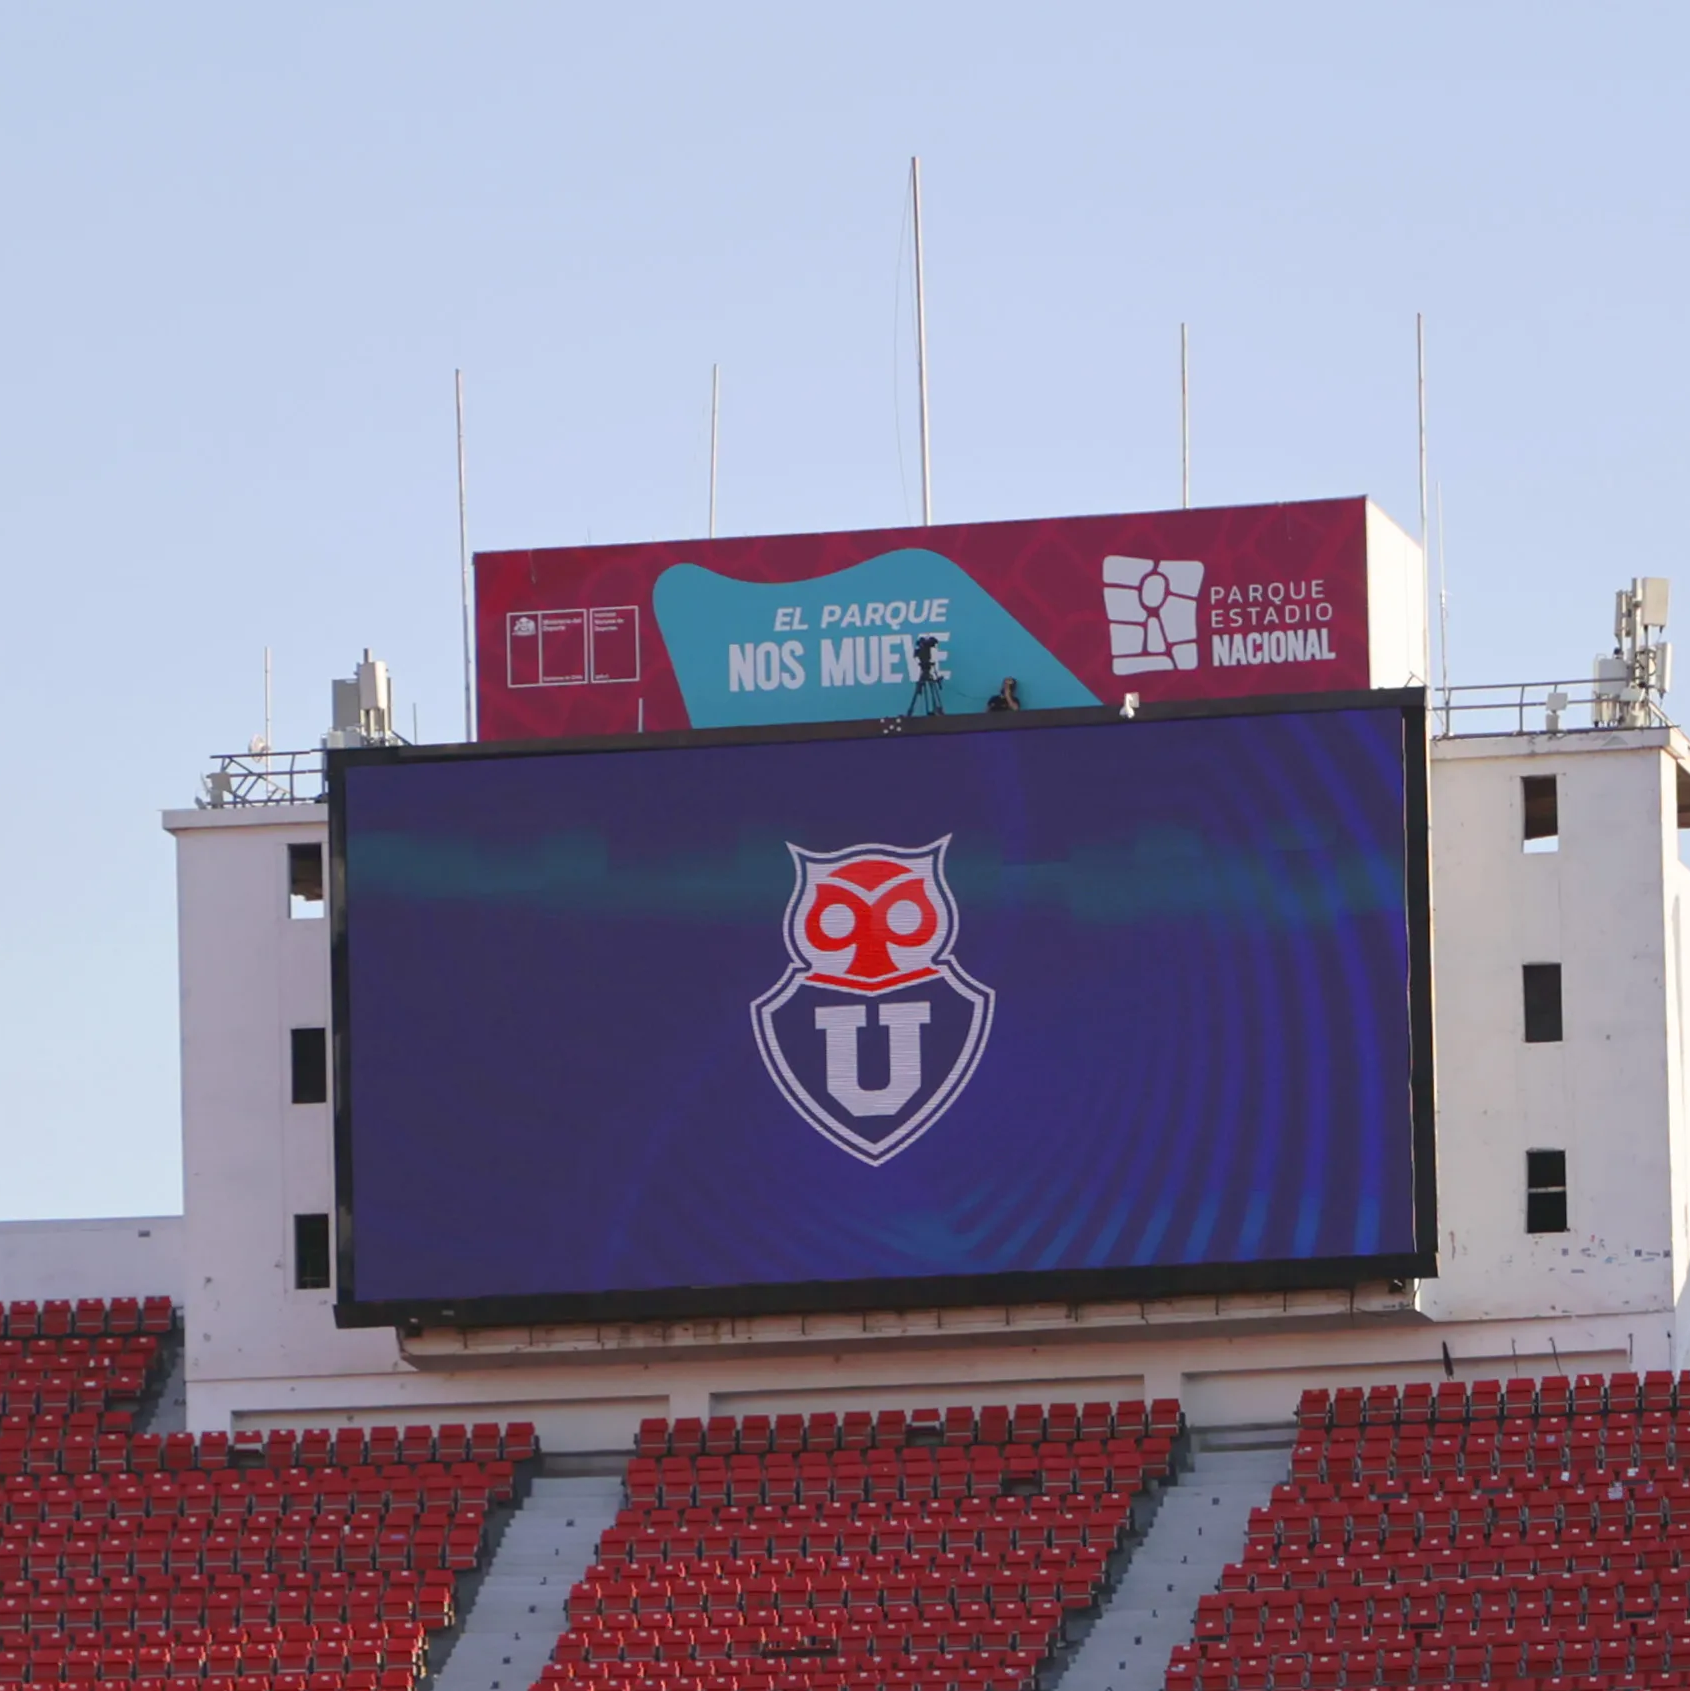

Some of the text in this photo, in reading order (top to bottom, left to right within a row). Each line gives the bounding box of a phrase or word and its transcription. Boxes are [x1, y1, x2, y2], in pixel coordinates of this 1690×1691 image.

[1210, 580, 1325, 605] PARQUE
[773, 599, 949, 631] EL PARQUE
[1211, 602, 1333, 628] ESTADIO
[1212, 628, 1336, 667] NACIONAL
[728, 640, 806, 692] NOS
[815, 1001, 931, 1117] U
